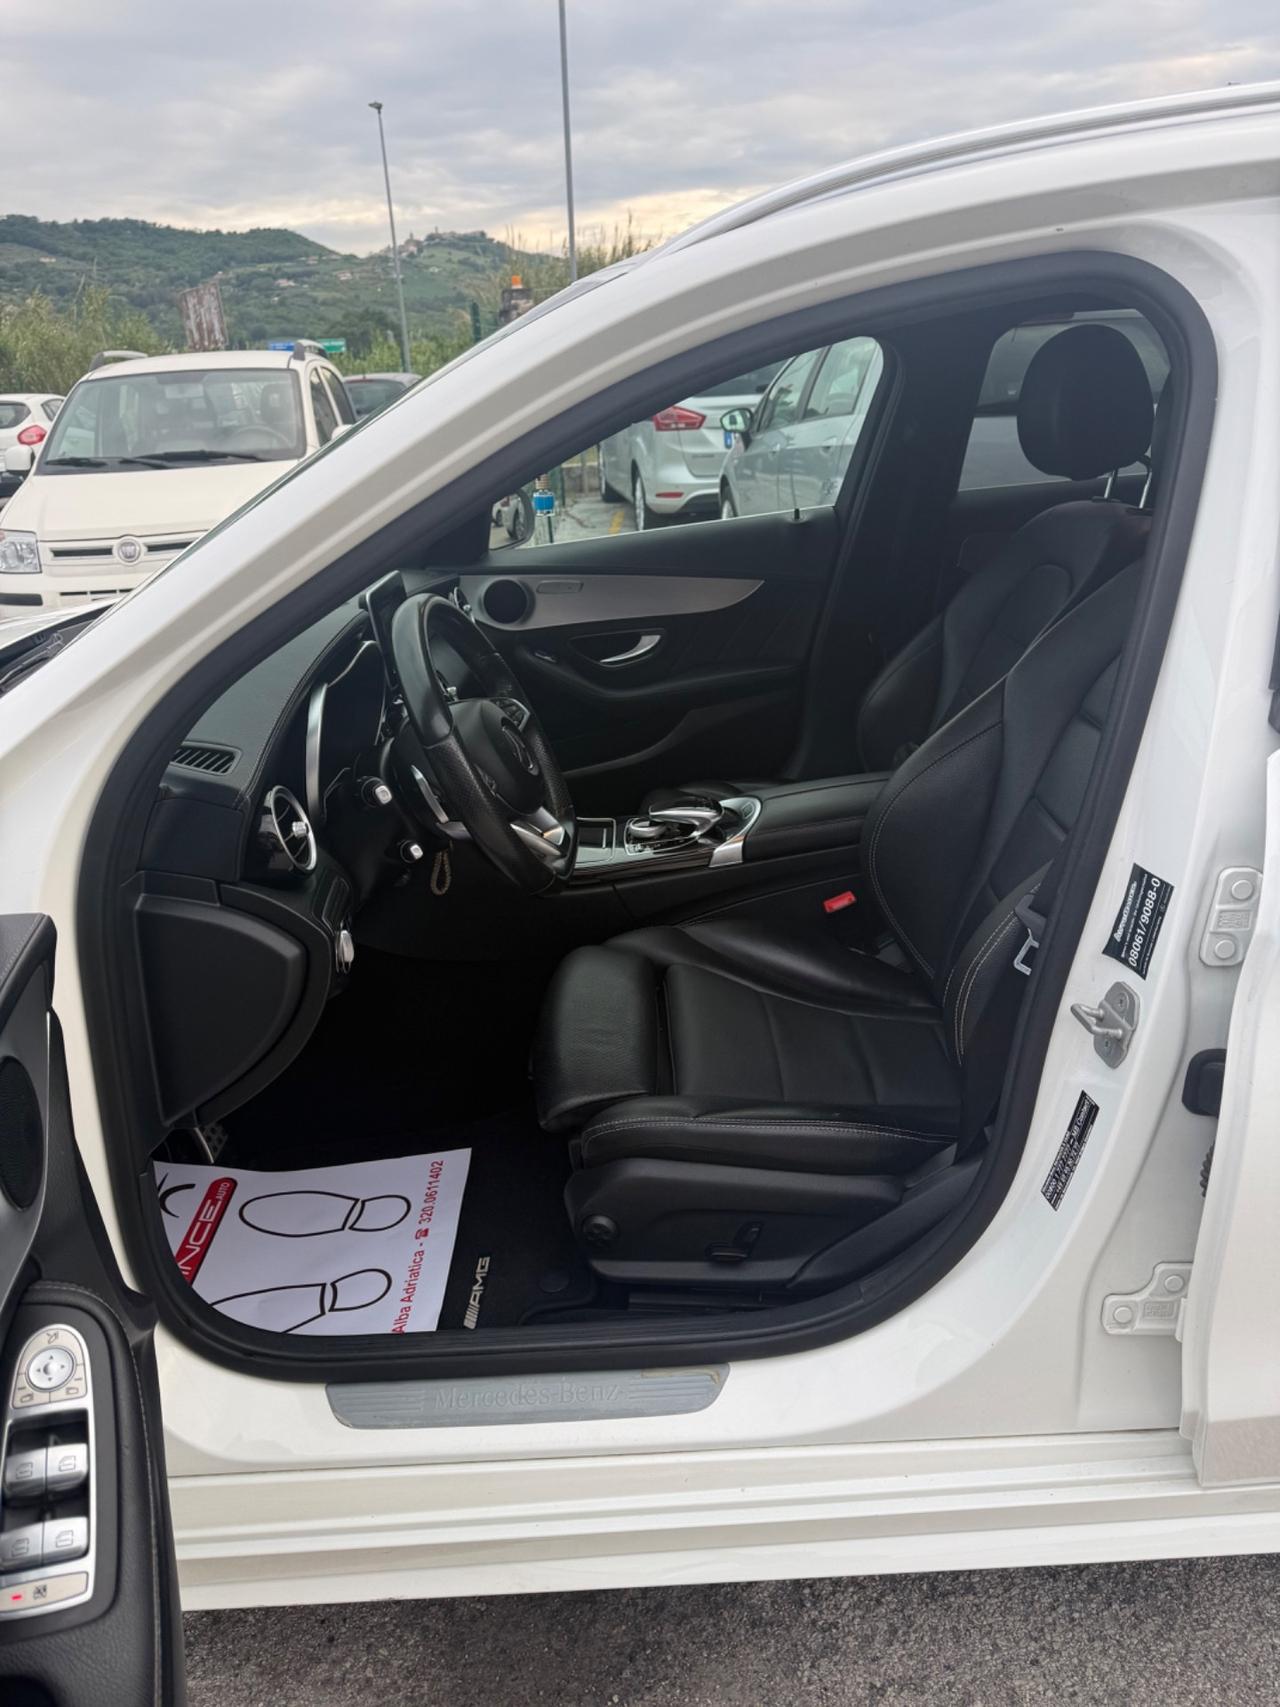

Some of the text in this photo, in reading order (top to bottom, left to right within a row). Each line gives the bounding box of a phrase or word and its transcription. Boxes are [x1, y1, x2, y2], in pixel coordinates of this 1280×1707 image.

[1128, 877, 1162, 967] 08061/9088-0
[215, 1182, 230, 1200] AUTO
[418, 1159, 444, 1225] 320.0611402
[400, 1250, 425, 1303] Adriatica
[391, 1305, 412, 1335] Alba
